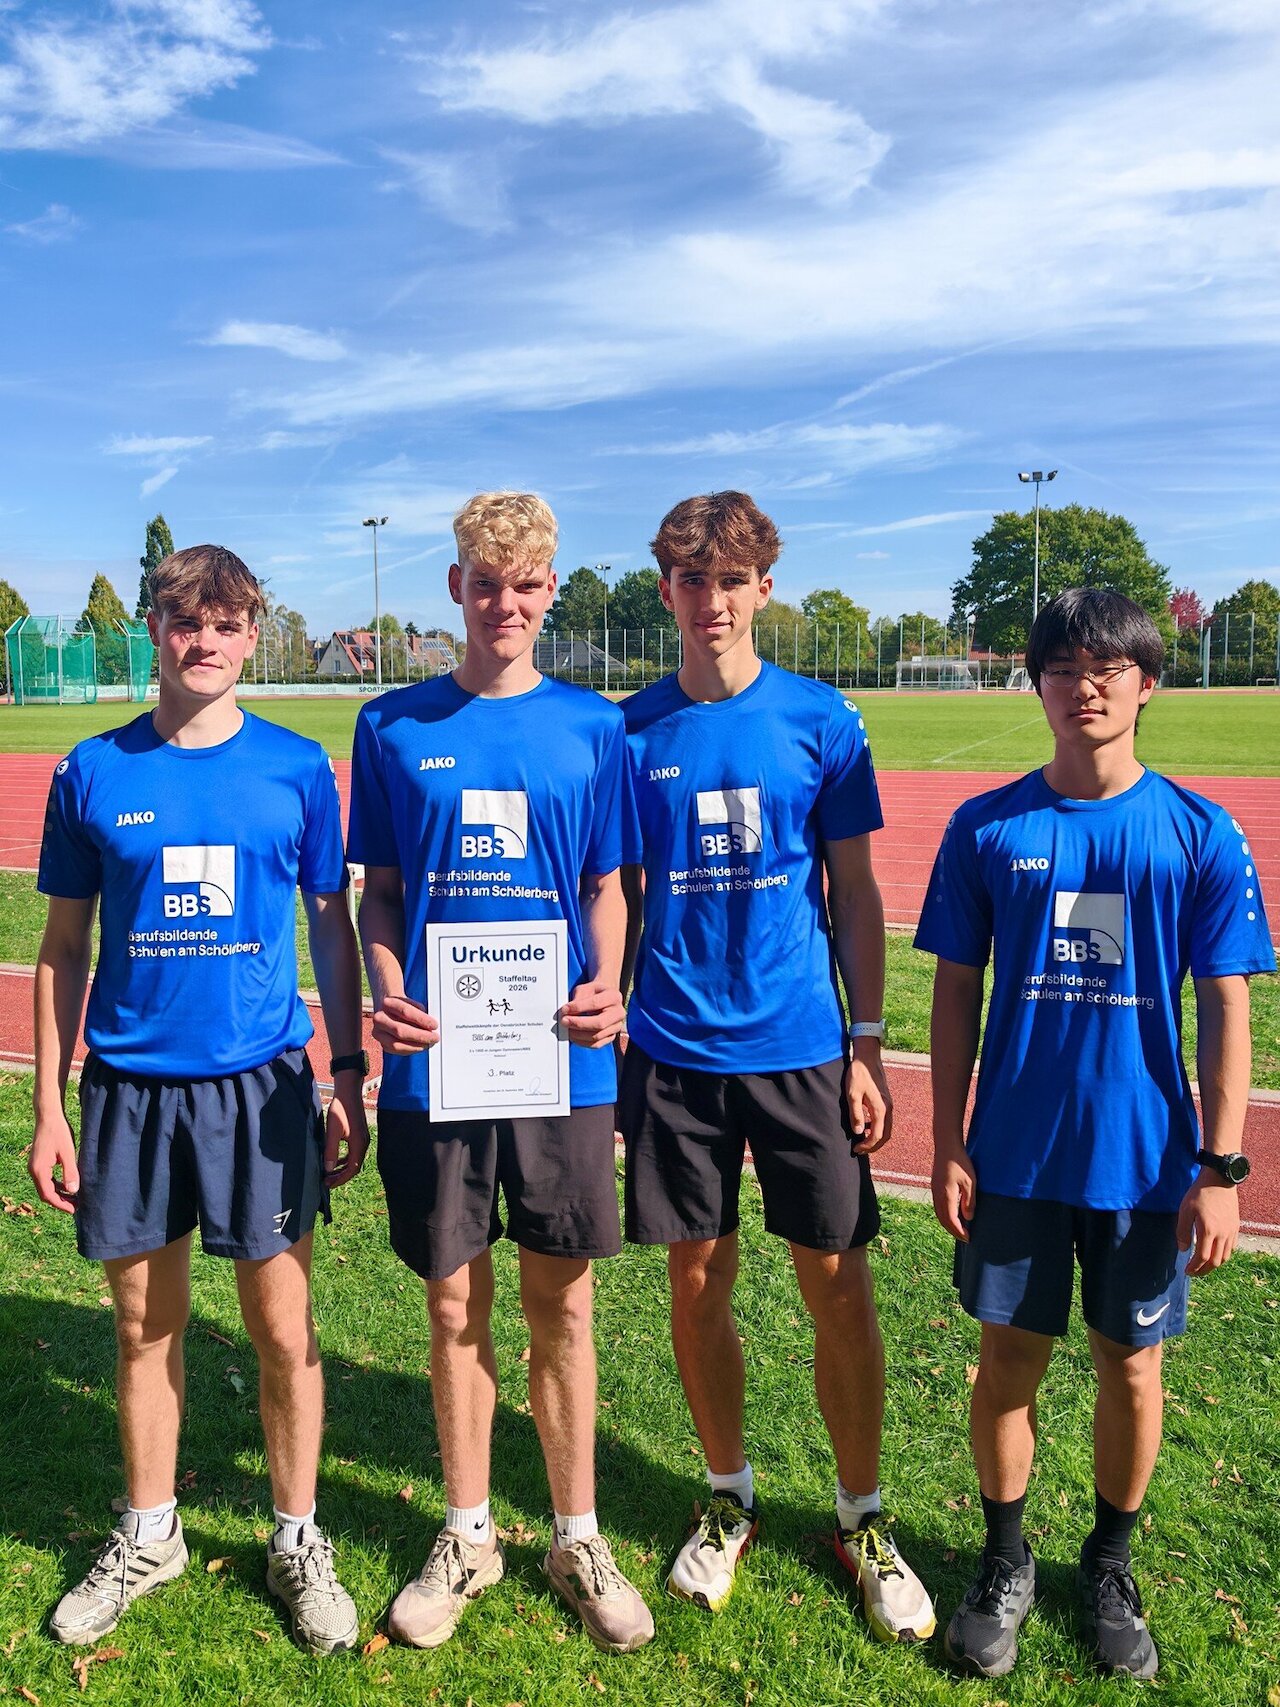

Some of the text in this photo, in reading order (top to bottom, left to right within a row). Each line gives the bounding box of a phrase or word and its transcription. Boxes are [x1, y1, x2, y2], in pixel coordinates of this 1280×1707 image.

[419, 756, 456, 771] JAKO
[649, 766, 681, 781] JAKO
[116, 811, 156, 827] JAKO
[461, 835, 505, 858] BBS
[701, 834, 743, 856] BBS
[1011, 857, 1049, 871] JAKO
[428, 870, 511, 883] Berufsbildende
[669, 865, 750, 882] Berufsbildende
[671, 874, 788, 896] Schulen am Schölrberg
[428, 885, 559, 903] Schulen am Schölerberg
[163, 894, 212, 918] BBS
[128, 929, 218, 942] Berufsbildende
[178, 947, 196, 956] am
[452, 944, 545, 963] Urkunde
[1053, 938, 1101, 963] BBS
[498, 974, 537, 984] Staffeltag
[1023, 973, 1107, 988] erufsbildende
[508, 984, 528, 992] 2026
[1064, 992, 1084, 1002] am
